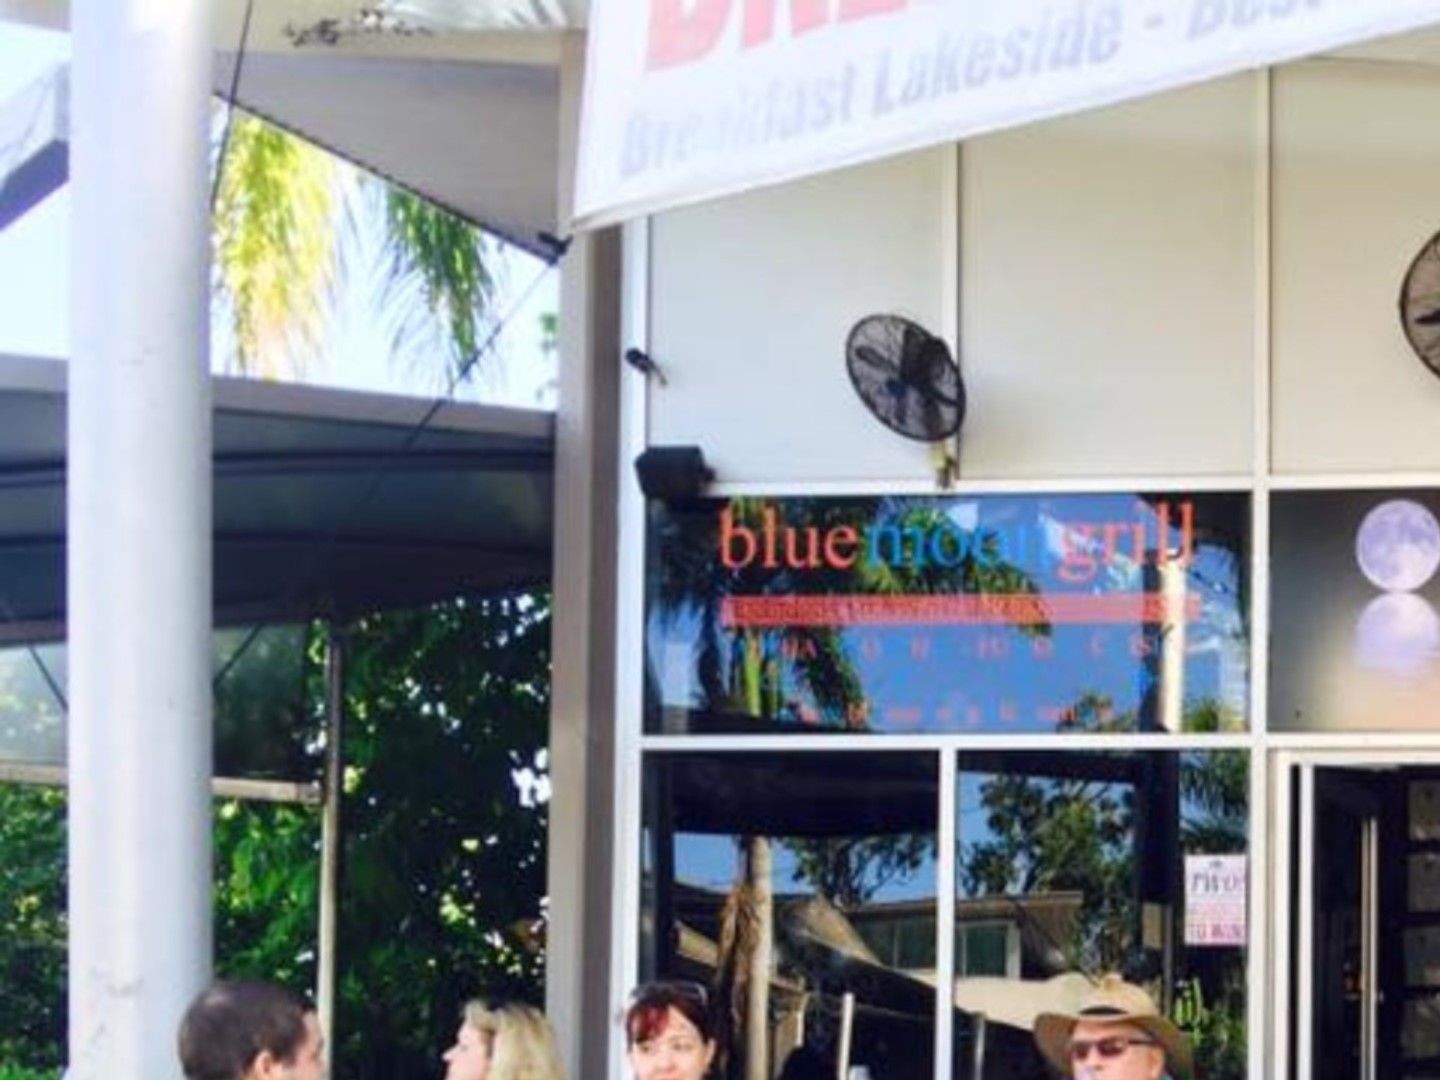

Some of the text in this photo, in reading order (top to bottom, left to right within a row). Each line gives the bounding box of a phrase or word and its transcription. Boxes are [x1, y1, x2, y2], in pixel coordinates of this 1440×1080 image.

[620, 58, 856, 178] Brekfast
[872, 4, 1124, 117] Lakeside
[720, 500, 1196, 583] bluemoongrill
